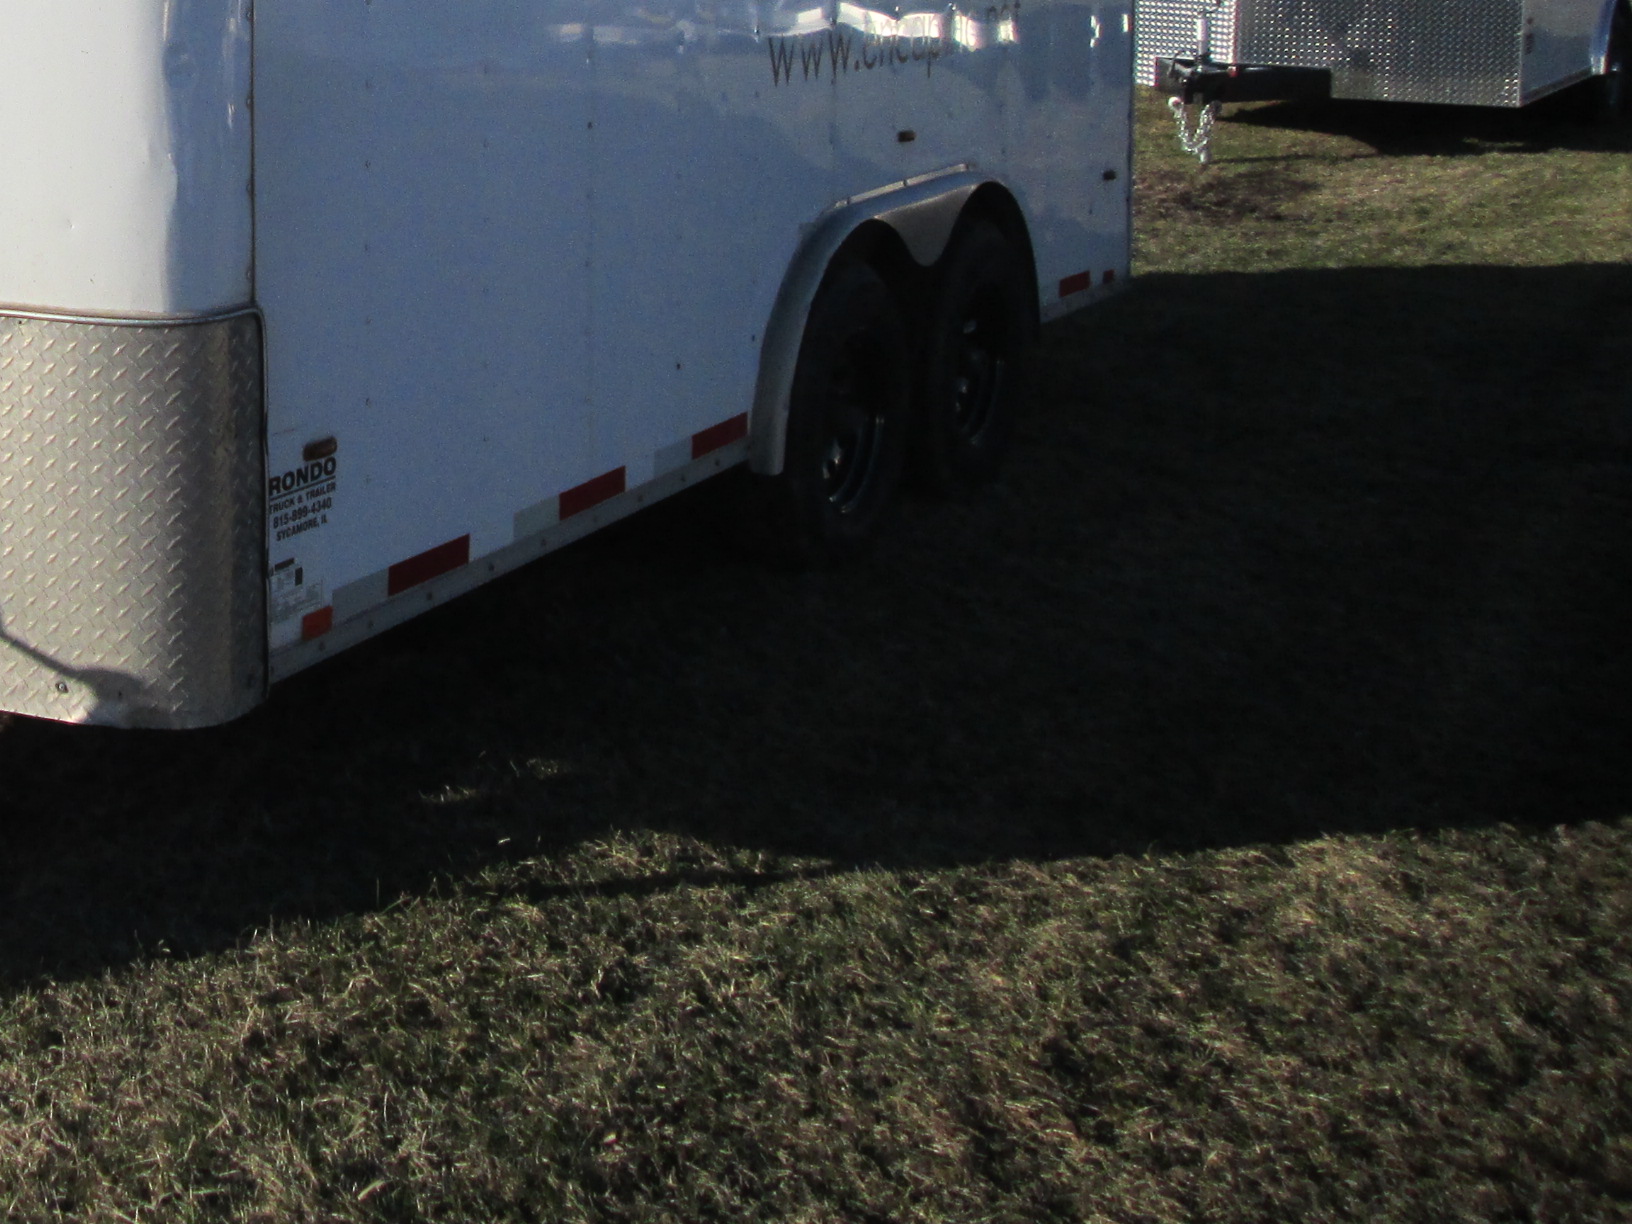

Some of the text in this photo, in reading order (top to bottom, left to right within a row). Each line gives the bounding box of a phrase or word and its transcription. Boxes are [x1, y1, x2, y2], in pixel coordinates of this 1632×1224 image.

[268, 457, 337, 496] RONDO
[269, 495, 296, 516] TRUCK
[305, 482, 337, 501] TRAILER
